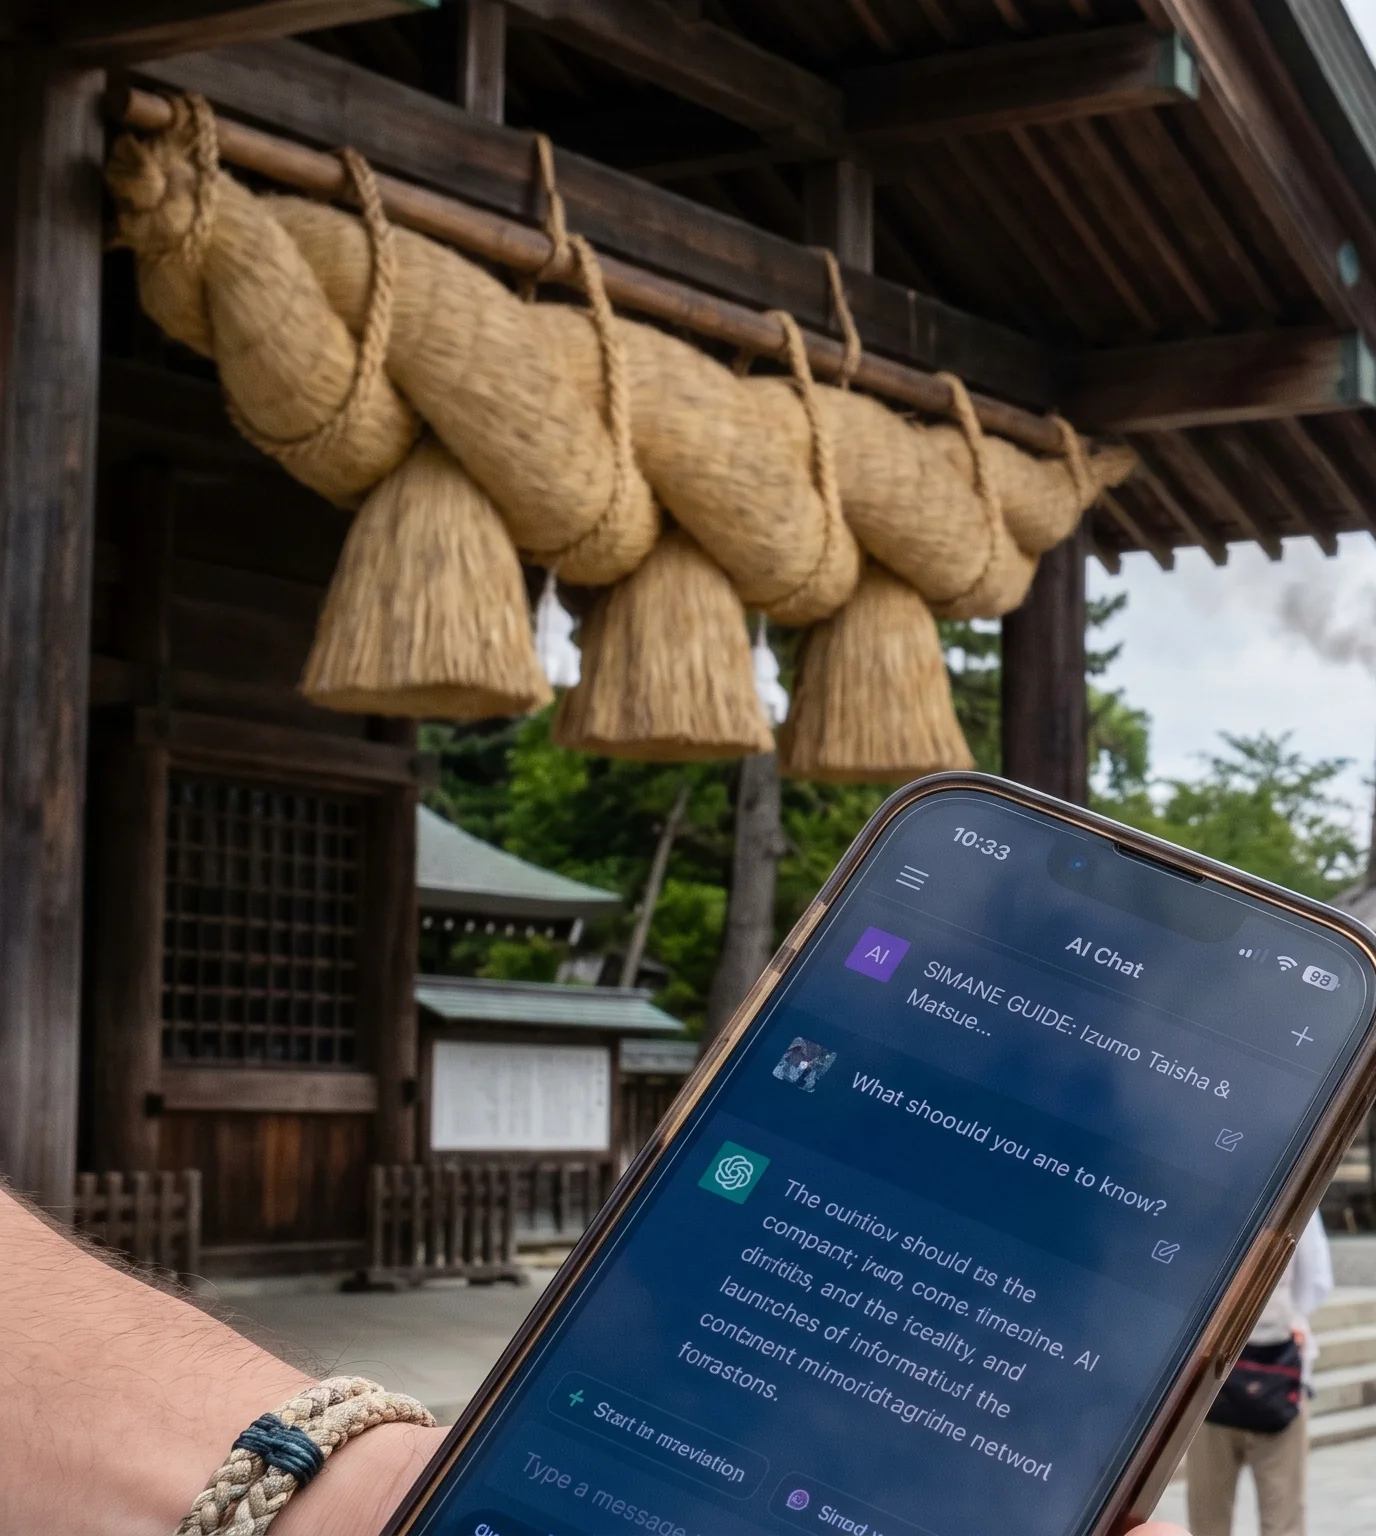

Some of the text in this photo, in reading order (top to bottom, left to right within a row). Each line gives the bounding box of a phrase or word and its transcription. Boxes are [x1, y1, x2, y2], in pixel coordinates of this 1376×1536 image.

[953, 827, 1011, 861] 10:33
[864, 945, 890, 965] AI
[1064, 937, 1144, 979] AI Chat
[1310, 971, 1331, 986] 98
[906, 988, 991, 1037] Matsue...
[923, 961, 1231, 1099] SIMANE GUIDE: Izumo Taisha &
[852, 1071, 905, 1107] What
[905, 1099, 992, 1143] shoould
[989, 1134, 1031, 1161] you
[1074, 1166, 1096, 1187] to
[1098, 1175, 1167, 1217] know?
[784, 1178, 821, 1209] The
[900, 1235, 973, 1275] should
[1002, 1276, 1037, 1303] the
[820, 1282, 864, 1309] and
[863, 1298, 898, 1325] the
[982, 1355, 1027, 1382] and
[824, 1326, 850, 1344] of
[976, 1390, 1011, 1418] the
[1073, 1350, 1100, 1372] AI
[523, 1451, 572, 1489] Type
[573, 1482, 589, 1498] a
